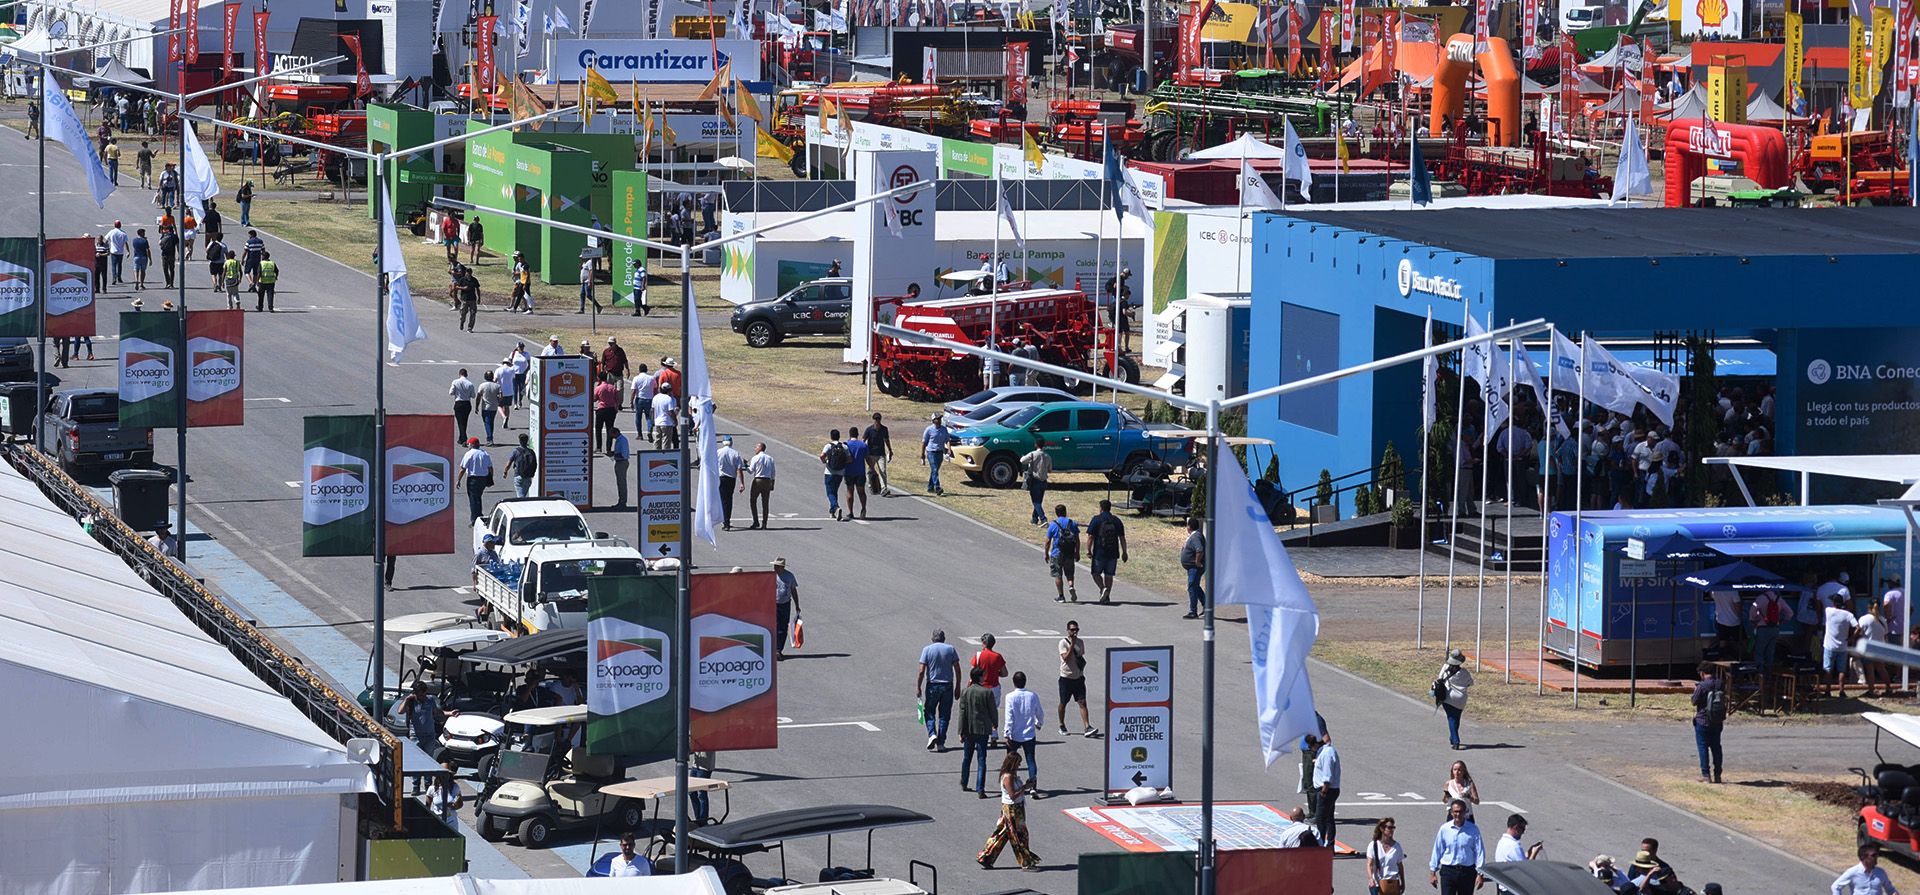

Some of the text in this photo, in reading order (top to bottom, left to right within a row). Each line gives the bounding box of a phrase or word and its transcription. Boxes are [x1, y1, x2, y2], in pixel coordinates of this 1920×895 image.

[481, 20, 490, 65] ALTINA
[578, 49, 708, 70] Garantizar
[1013, 45, 1024, 84] ALTINA
[624, 186, 634, 224] Pampa
[1200, 231, 1217, 241] ICBC
[1013, 250, 1024, 260] La
[1028, 250, 1066, 262] Pampa
[624, 256, 632, 286] Banco
[51, 286, 89, 295] Expoagro
[824, 311, 849, 319] Campo
[126, 368, 170, 380] Expoagro
[193, 366, 236, 379] Expoagro
[1836, 364, 1872, 381] BNA
[152, 378, 170, 388] agro
[218, 376, 236, 387] agro
[1806, 400, 1920, 415] Llegá con tus productos
[1806, 414, 1870, 428] a todo el país
[649, 471, 679, 479] Expoagro
[311, 484, 365, 497] Expoagro
[392, 482, 445, 496] Expoagro
[342, 498, 365, 508] agro
[423, 497, 445, 507] agro
[596, 664, 663, 680] Expoagro
[699, 660, 766, 677] Expoagro
[738, 676, 766, 689] agro
[1121, 675, 1160, 686] Expoagro
[636, 681, 664, 694] agro
[1144, 685, 1160, 693] agro
[1119, 715, 1161, 725] AUDITORIO
[1124, 723, 1156, 733] AGTECH
[1115, 731, 1164, 742] JOHN DEERE
